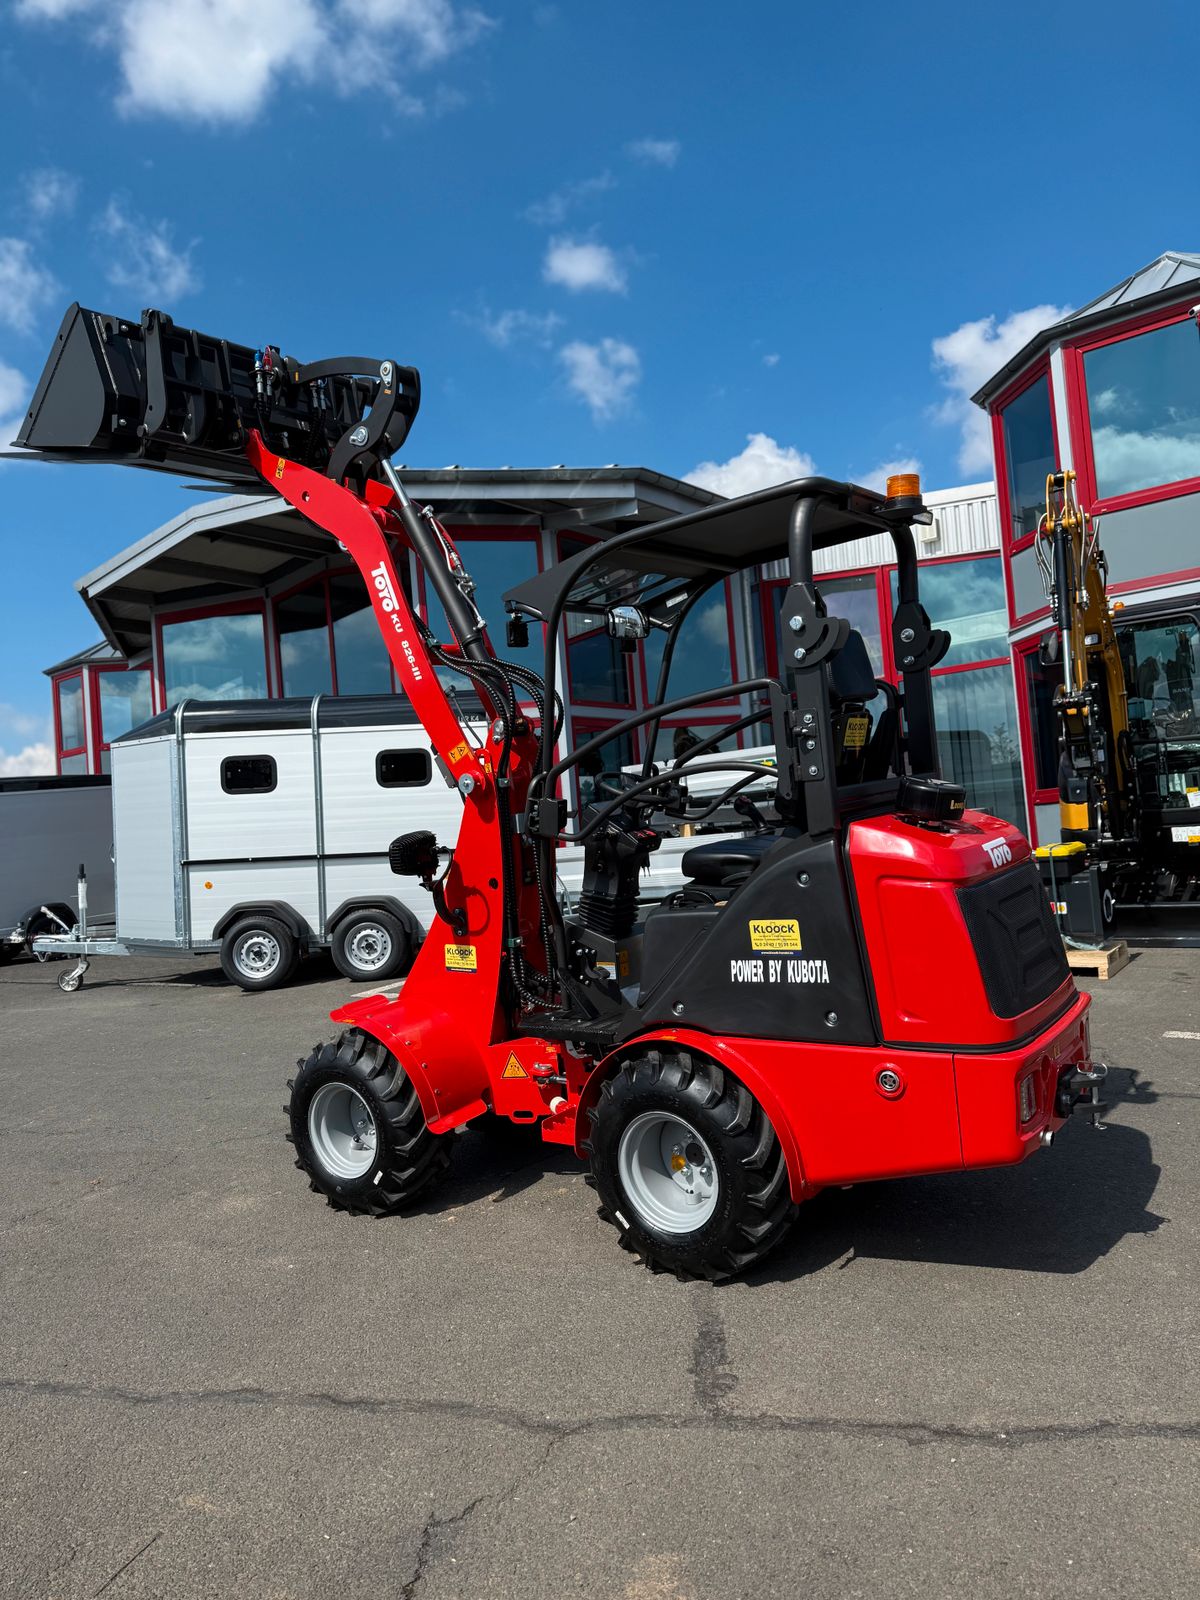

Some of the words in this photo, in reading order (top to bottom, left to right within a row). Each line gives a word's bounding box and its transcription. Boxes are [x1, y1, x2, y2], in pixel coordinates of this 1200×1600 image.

[371, 561, 400, 612] TOYO
[390, 614, 404, 633] KU
[401, 640, 422, 681] 826-III
[981, 837, 1012, 868] TOYO
[753, 924, 795, 934] KLOOCK
[446, 948, 474, 956] KLOOCK
[731, 960, 764, 983] POWER
[768, 960, 782, 983] BY
[787, 960, 830, 984] KUBOTA
